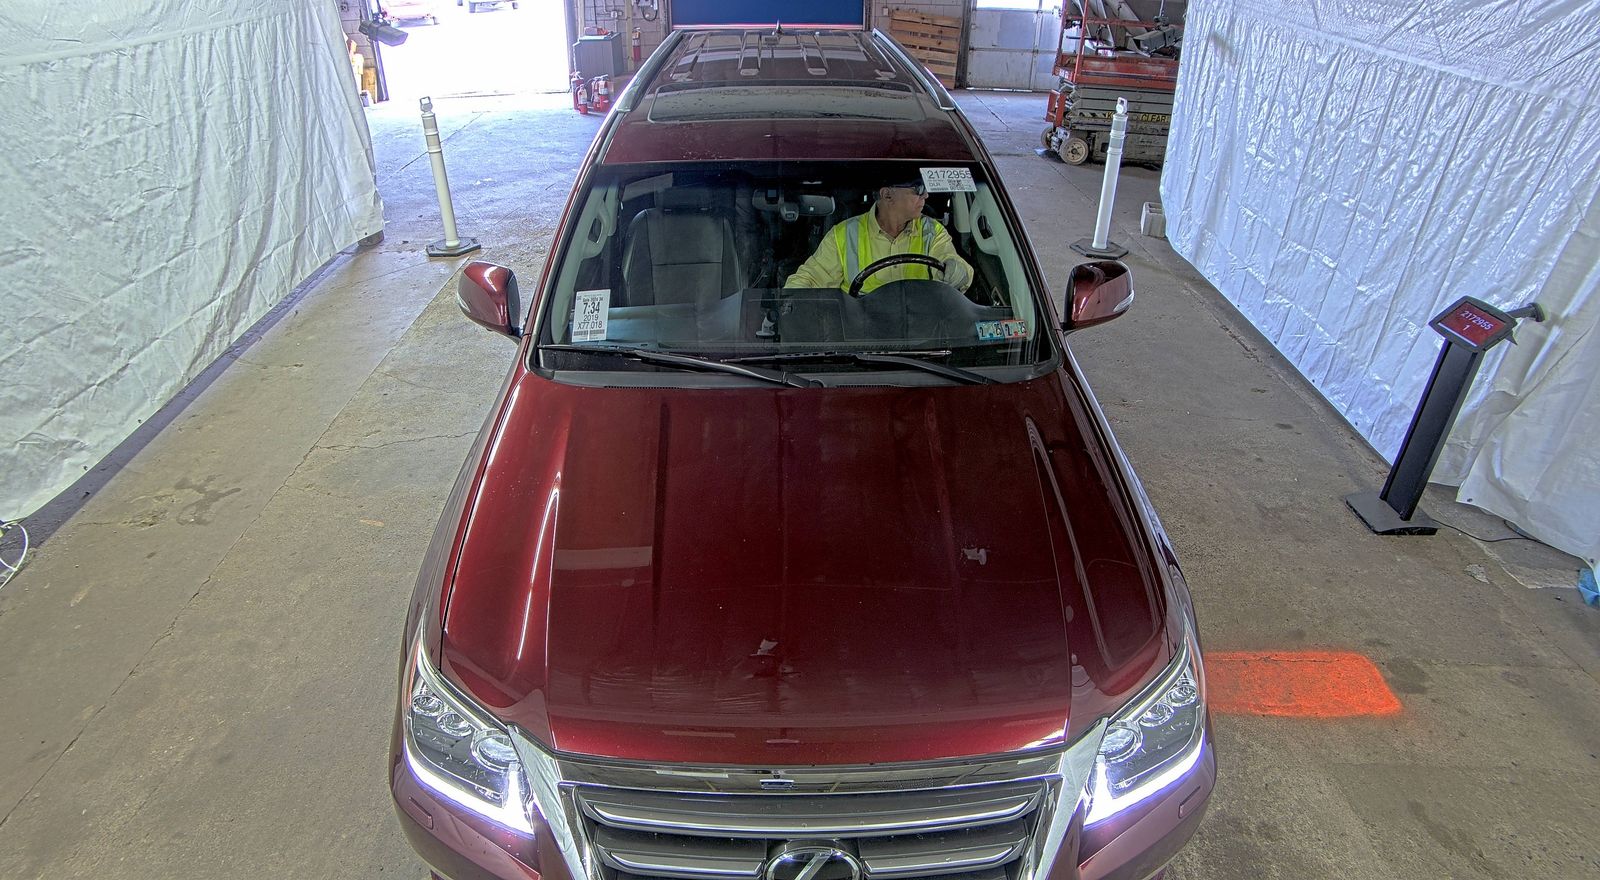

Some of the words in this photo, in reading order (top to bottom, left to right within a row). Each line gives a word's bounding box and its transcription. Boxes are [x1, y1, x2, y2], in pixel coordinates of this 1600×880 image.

[927, 170, 972, 179] 2172955
[583, 302, 600, 314] 7:34
[1460, 310, 1494, 330] 2172955
